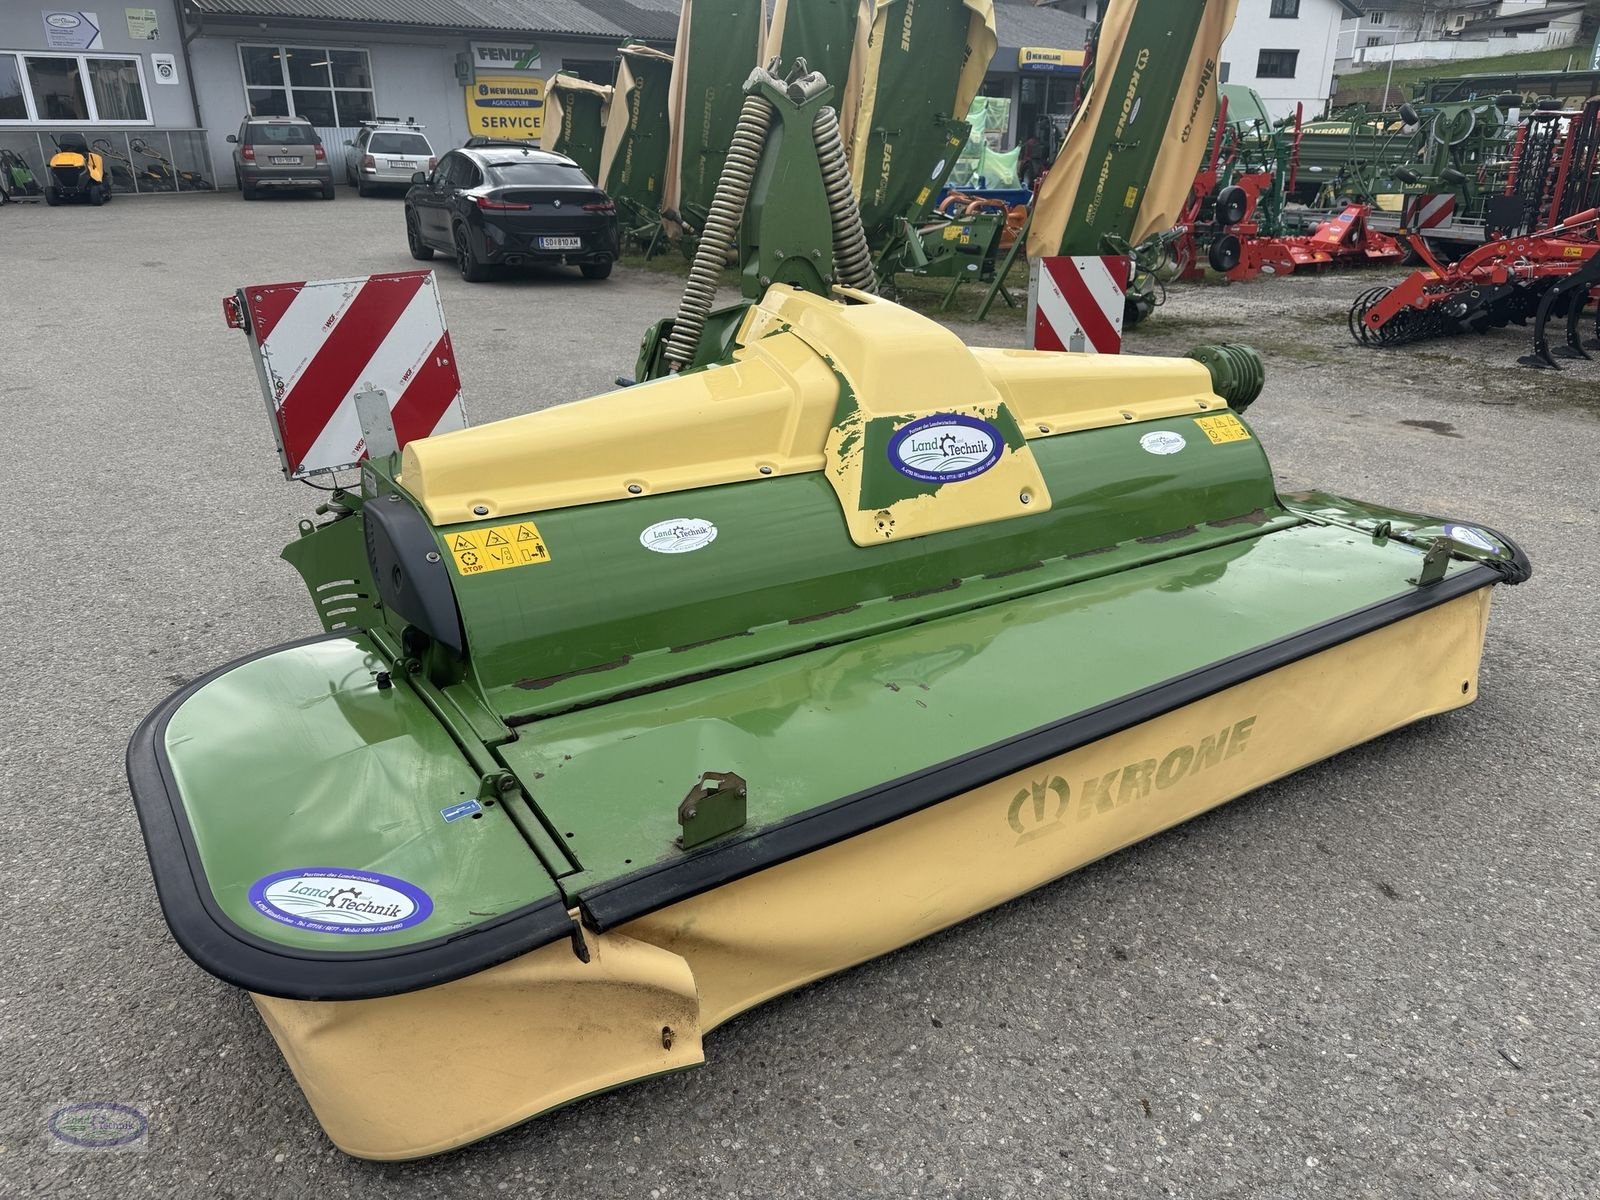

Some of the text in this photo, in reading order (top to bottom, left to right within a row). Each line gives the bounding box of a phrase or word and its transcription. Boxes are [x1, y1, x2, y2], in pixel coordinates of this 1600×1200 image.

[490, 87, 538, 95] NEW HOLLAND
[1189, 58, 1215, 122] KRONE
[631, 89, 641, 131] KRONE
[1115, 71, 1141, 138] KRONE
[481, 116, 540, 128] SERVICE
[564, 105, 574, 142] KRONE
[325, 314, 336, 328] WGF
[403, 368, 413, 381] WGF
[912, 437, 938, 452] Land
[948, 440, 987, 456] Technik
[653, 528, 673, 538] Land
[679, 526, 708, 538] Technik
[463, 565, 483, 573] STOP
[1076, 714, 1257, 822] KRONE
[288, 881, 335, 898] Land
[337, 897, 402, 917] Technik
